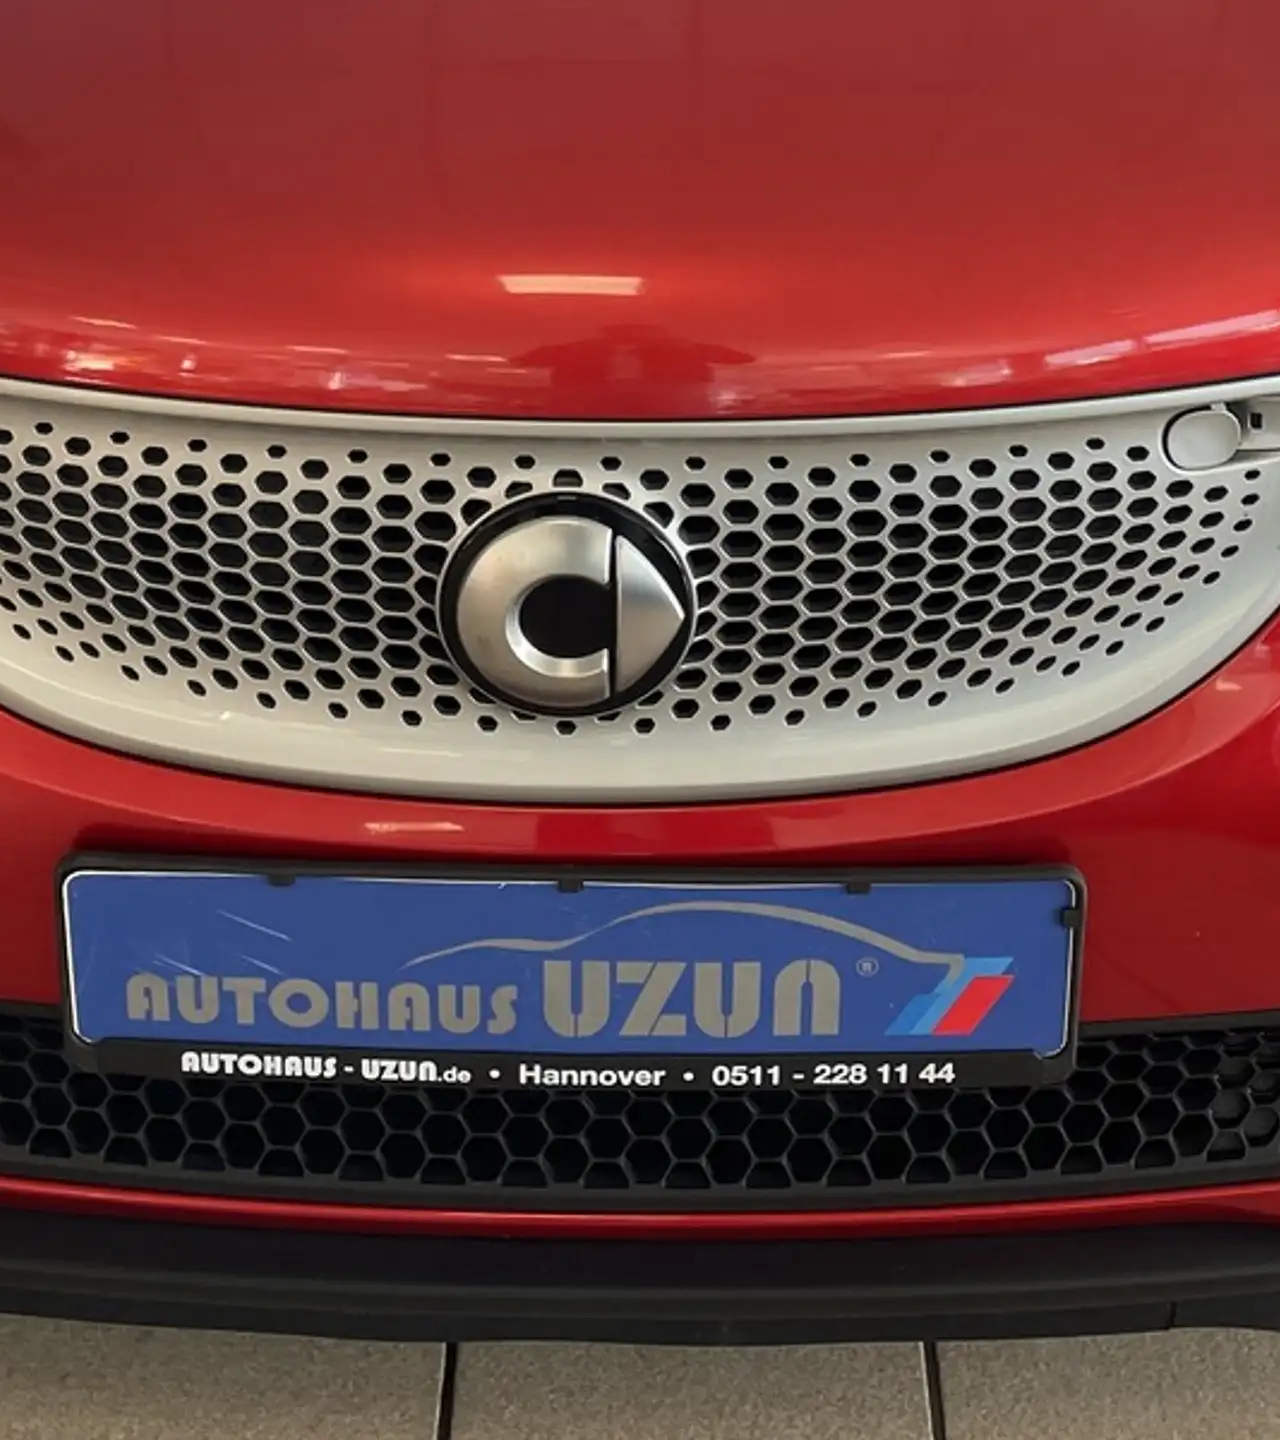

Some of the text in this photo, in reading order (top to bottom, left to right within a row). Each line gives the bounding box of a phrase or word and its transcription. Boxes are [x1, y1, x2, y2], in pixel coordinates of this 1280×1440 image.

[125, 971, 519, 1035] AUTOHAUS
[542, 958, 842, 1039] UZUN
[180, 1050, 339, 1079] AUTOHAUS
[361, 1057, 473, 1085] UZUN.de
[519, 1063, 667, 1088] Hannover
[710, 1064, 781, 1087] 0511
[813, 1063, 868, 1085] 228
[878, 1063, 909, 1085] 11
[918, 1062, 956, 1084] 44
